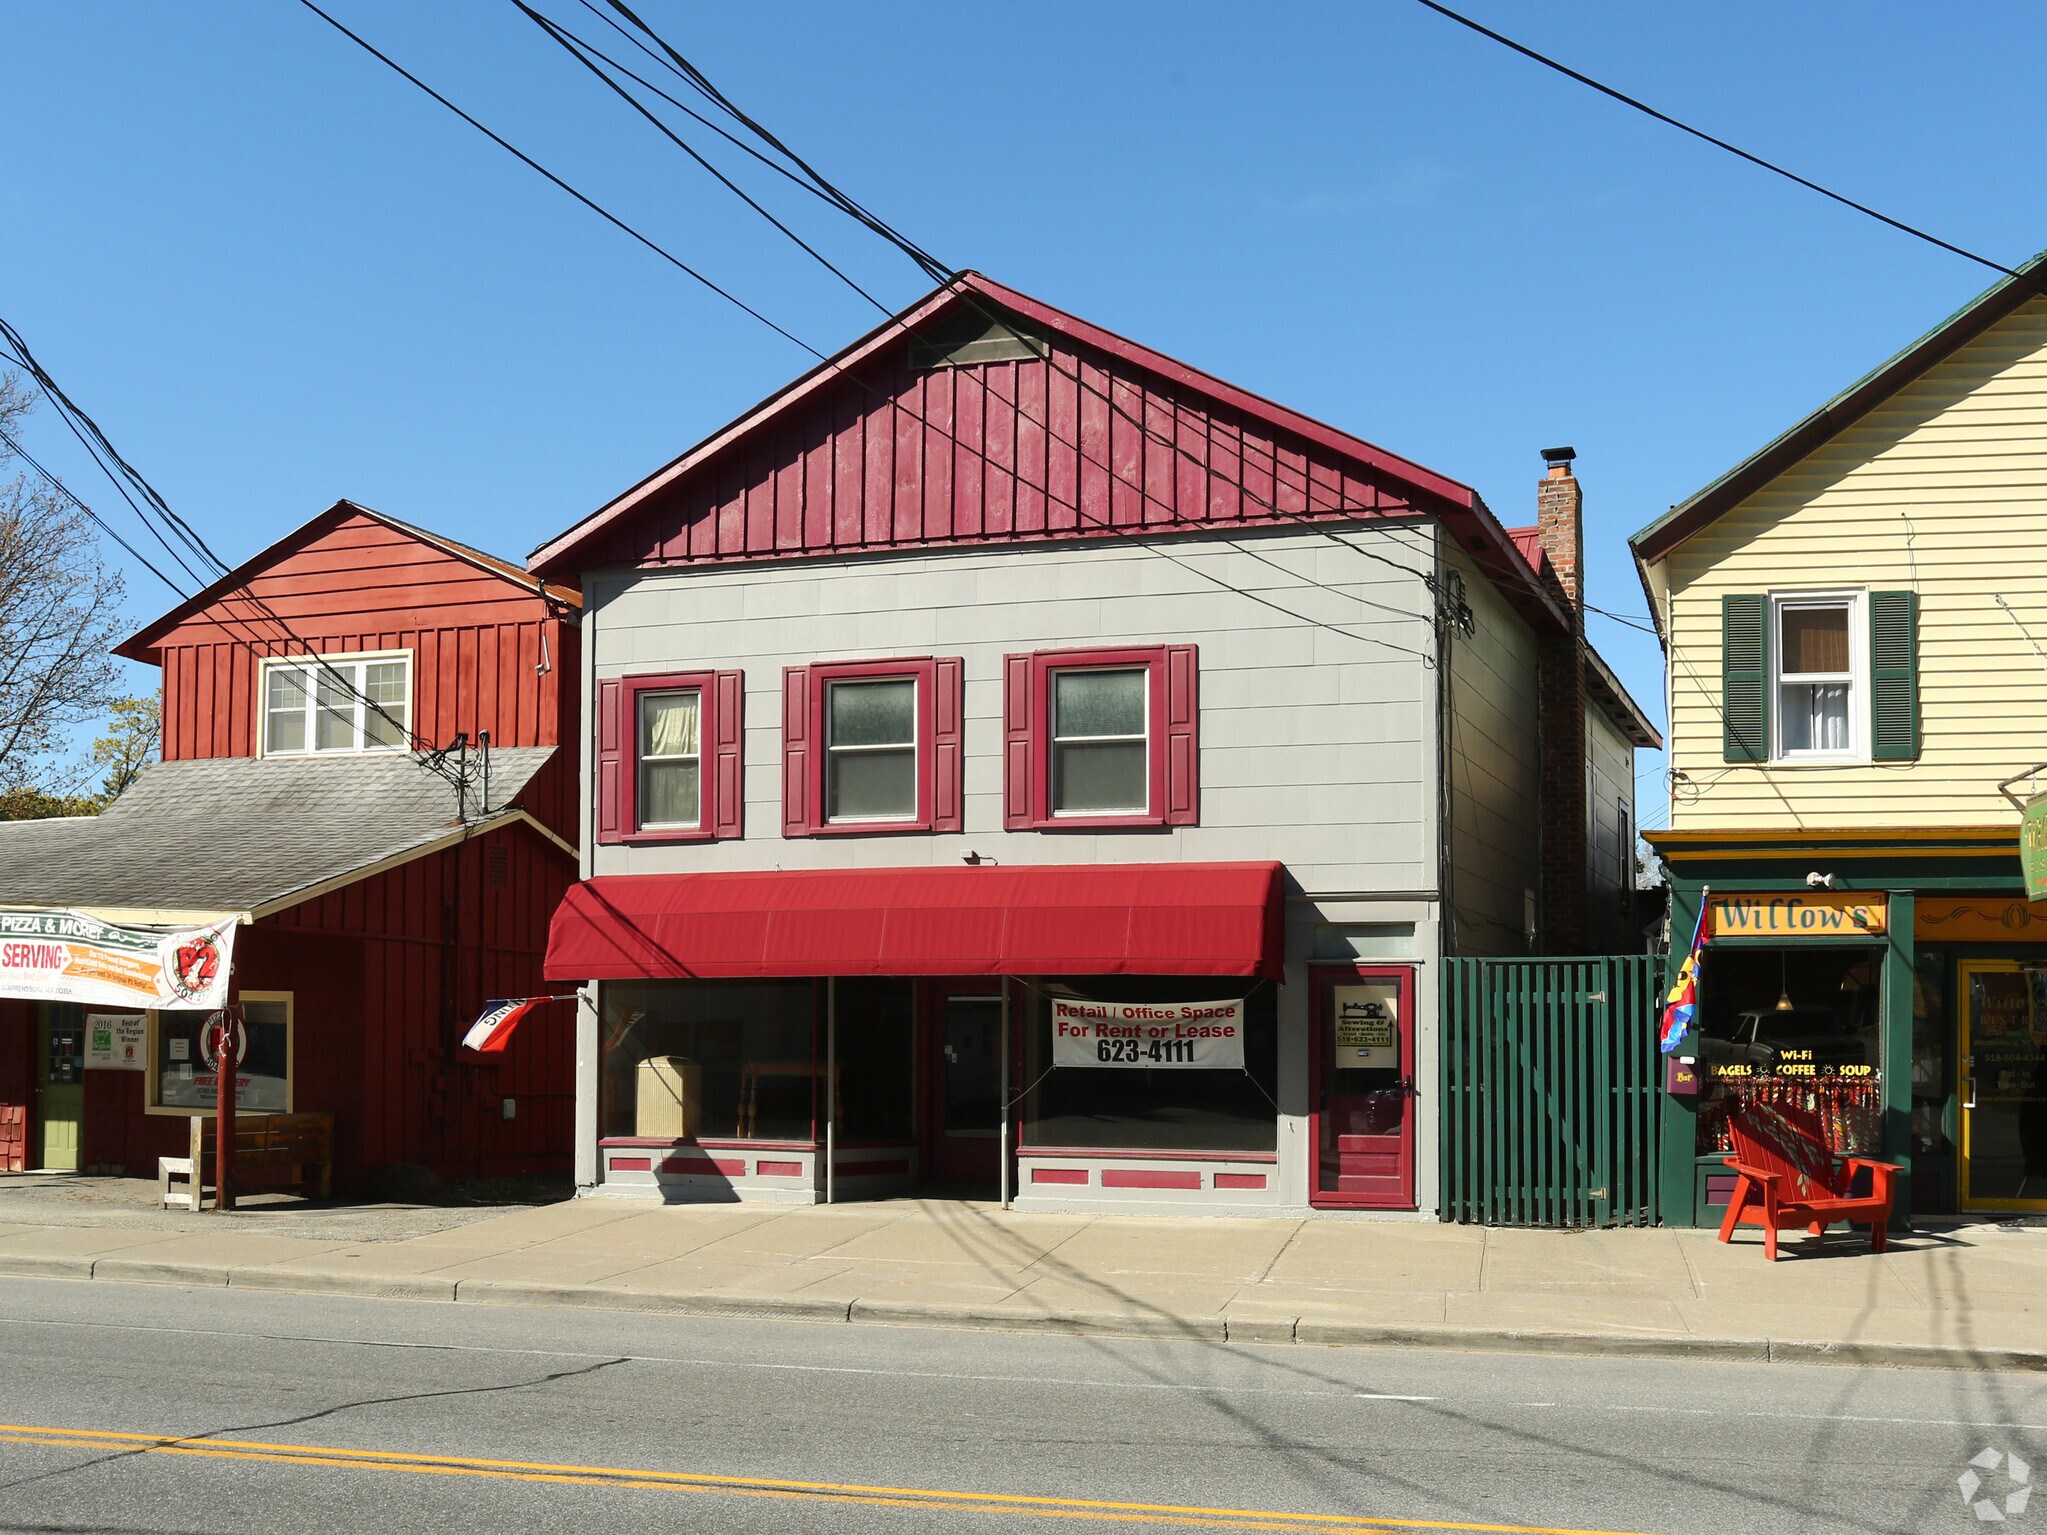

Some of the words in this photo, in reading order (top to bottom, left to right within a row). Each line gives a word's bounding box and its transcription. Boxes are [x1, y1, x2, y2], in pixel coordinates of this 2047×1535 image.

[1, 916, 41, 933] PIZZA
[45, 918, 56, 934] &
[2, 943, 62, 969] SERVING
[177, 944, 217, 979] P2
[1056, 1004, 1107, 1019] Retail
[1122, 1007, 1175, 1019] Office
[1180, 1006, 1235, 1021] Space
[94, 1020, 112, 1030] 2016
[126, 1028, 144, 1036] Region
[1057, 1022, 1090, 1037] For
[1095, 1023, 1141, 1038] Rent
[1149, 1026, 1168, 1038] or
[1175, 1024, 1235, 1038] Lease
[1097, 1039, 1195, 1063] 623-4111
[1780, 1050, 1813, 1060] Wi-Fi
[1984, 1053, 2046, 1063] 518-504-4344
[1711, 1065, 1752, 1076] BAGELS
[1776, 1065, 1816, 1076] COFFEE
[1839, 1065, 1872, 1076] SOUP
